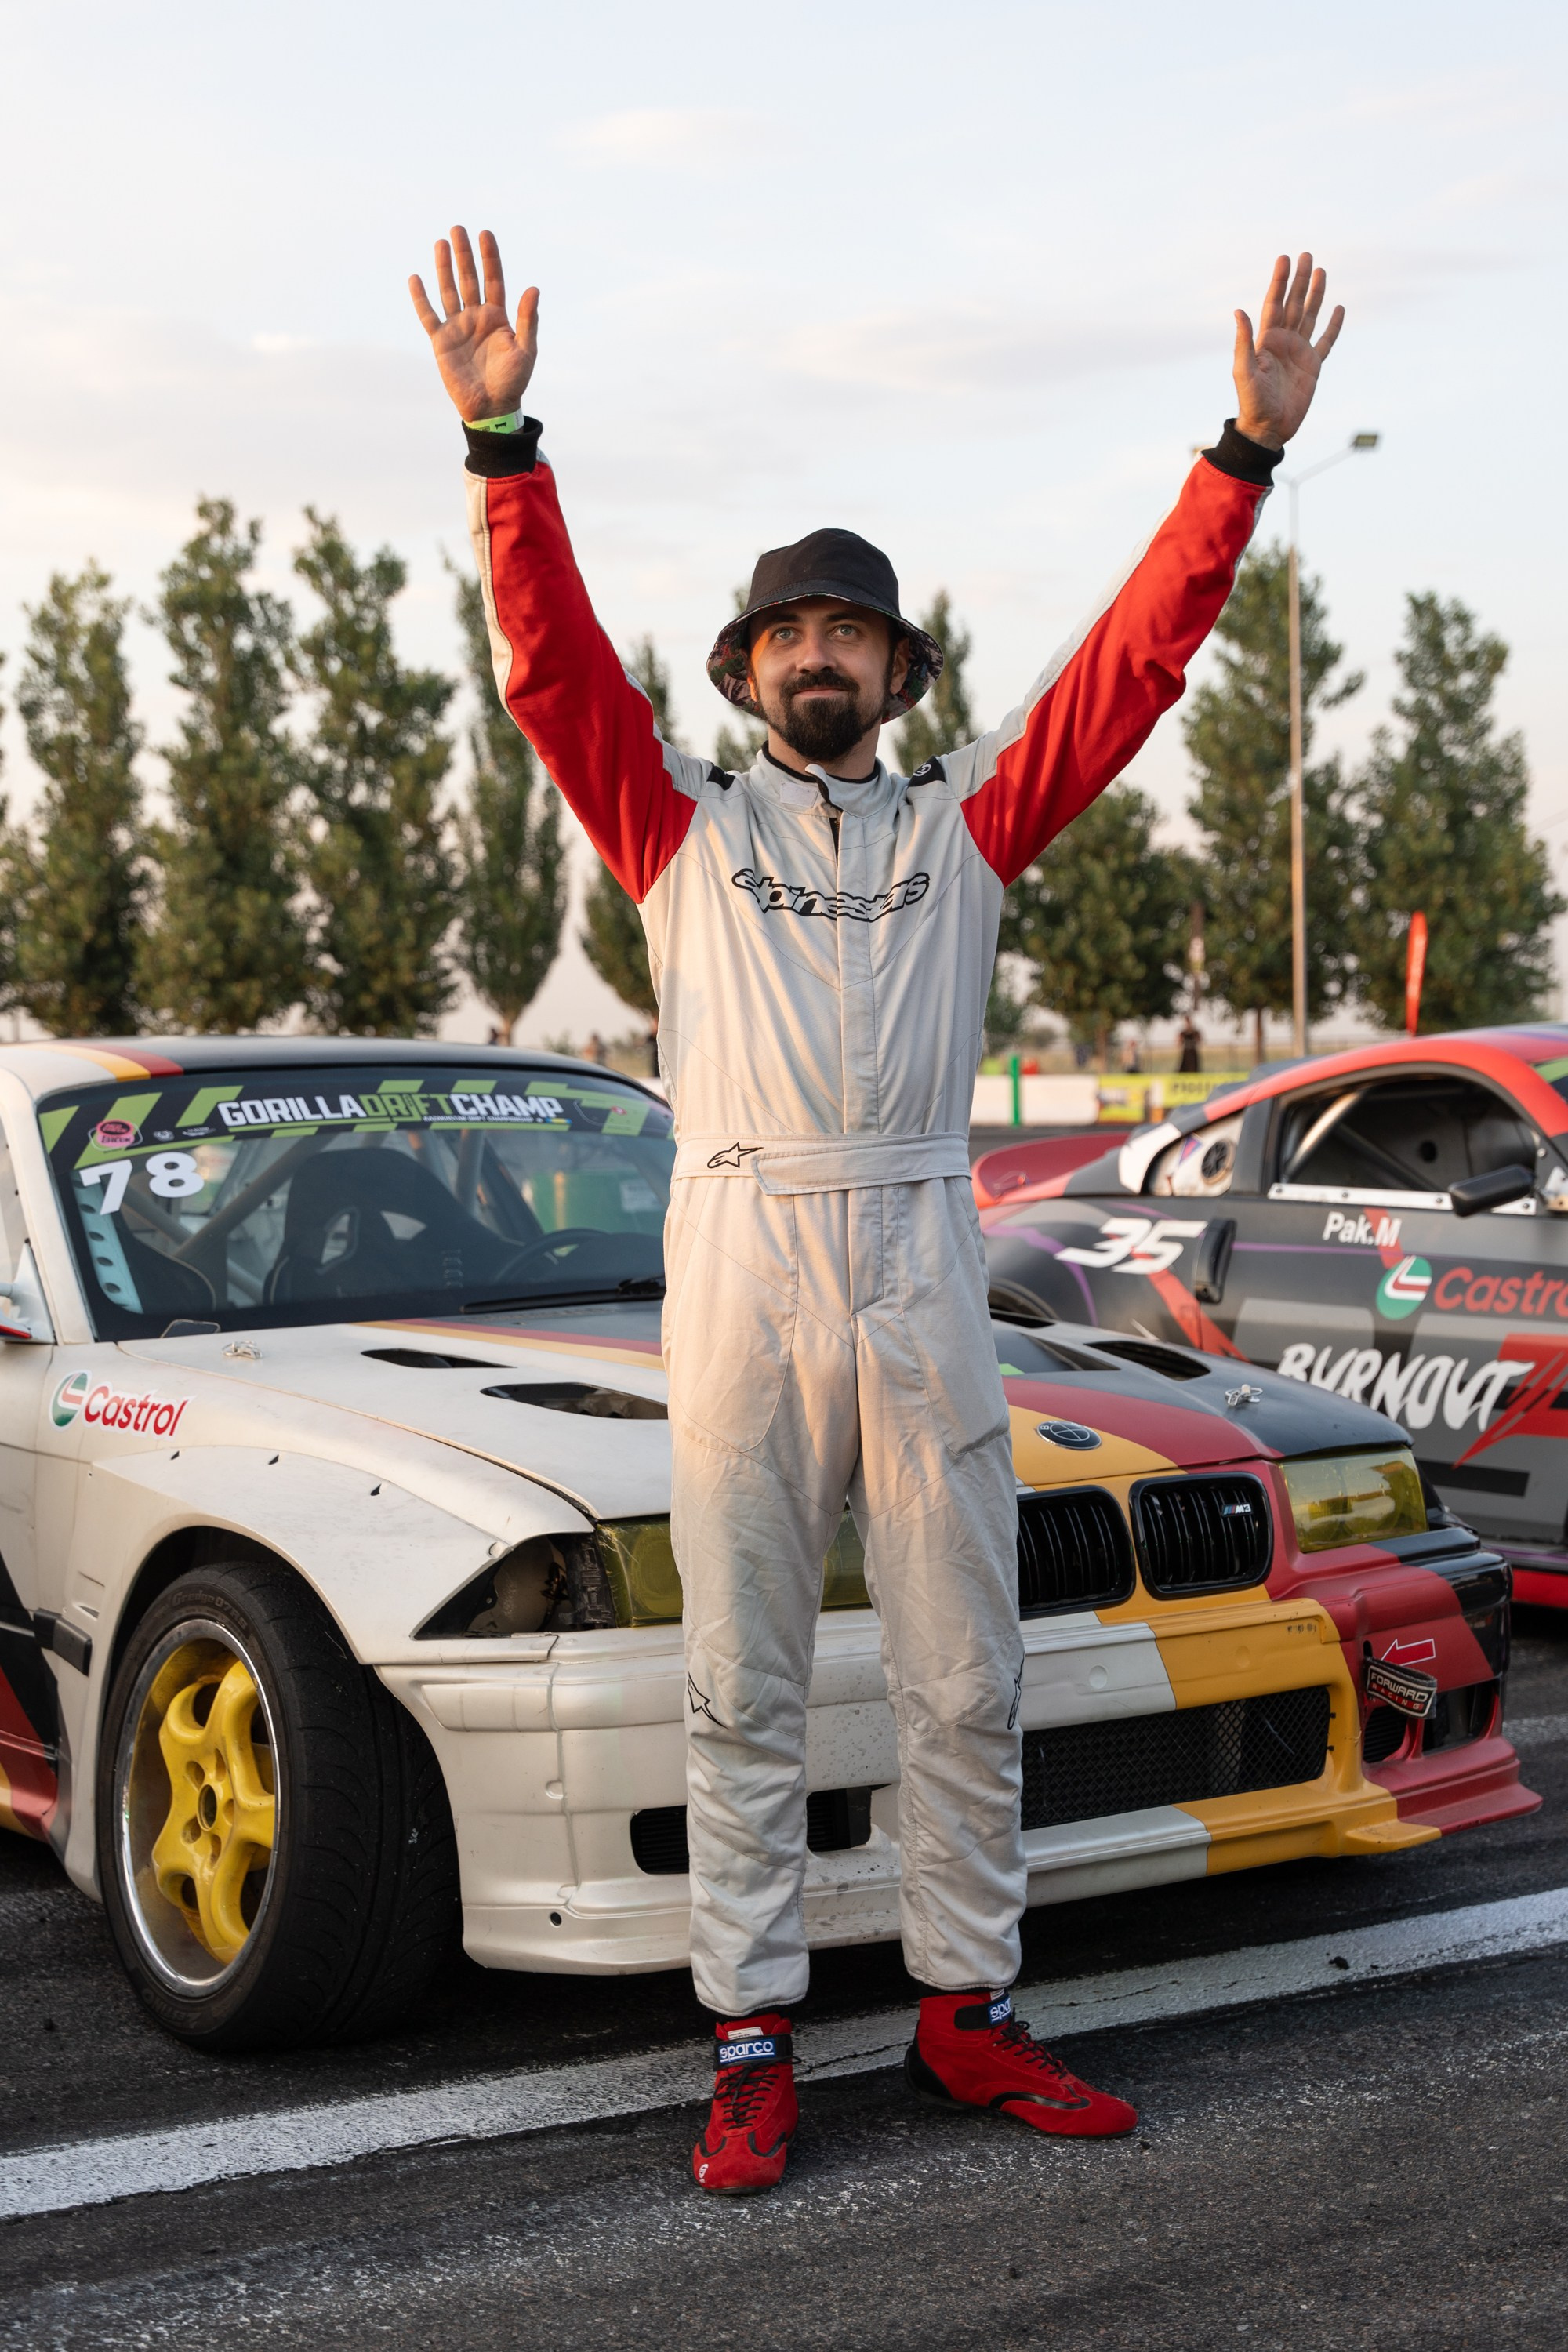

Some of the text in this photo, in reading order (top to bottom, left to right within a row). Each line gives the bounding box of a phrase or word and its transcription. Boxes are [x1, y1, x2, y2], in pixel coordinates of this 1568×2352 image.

[79, 1151, 205, 1215] 78
[1054, 1218, 1208, 1274] 35
[1322, 1212, 1402, 1247] Pak.M
[1276, 1343, 1535, 1432] BURNOUT
[84, 1385, 190, 1436] Castrol
[1235, 1504, 1251, 1514] M3
[1370, 1672, 1428, 1703] FORWARD
[1371, 1682, 1421, 1710] RACING
[720, 2041, 774, 2062] sparco
